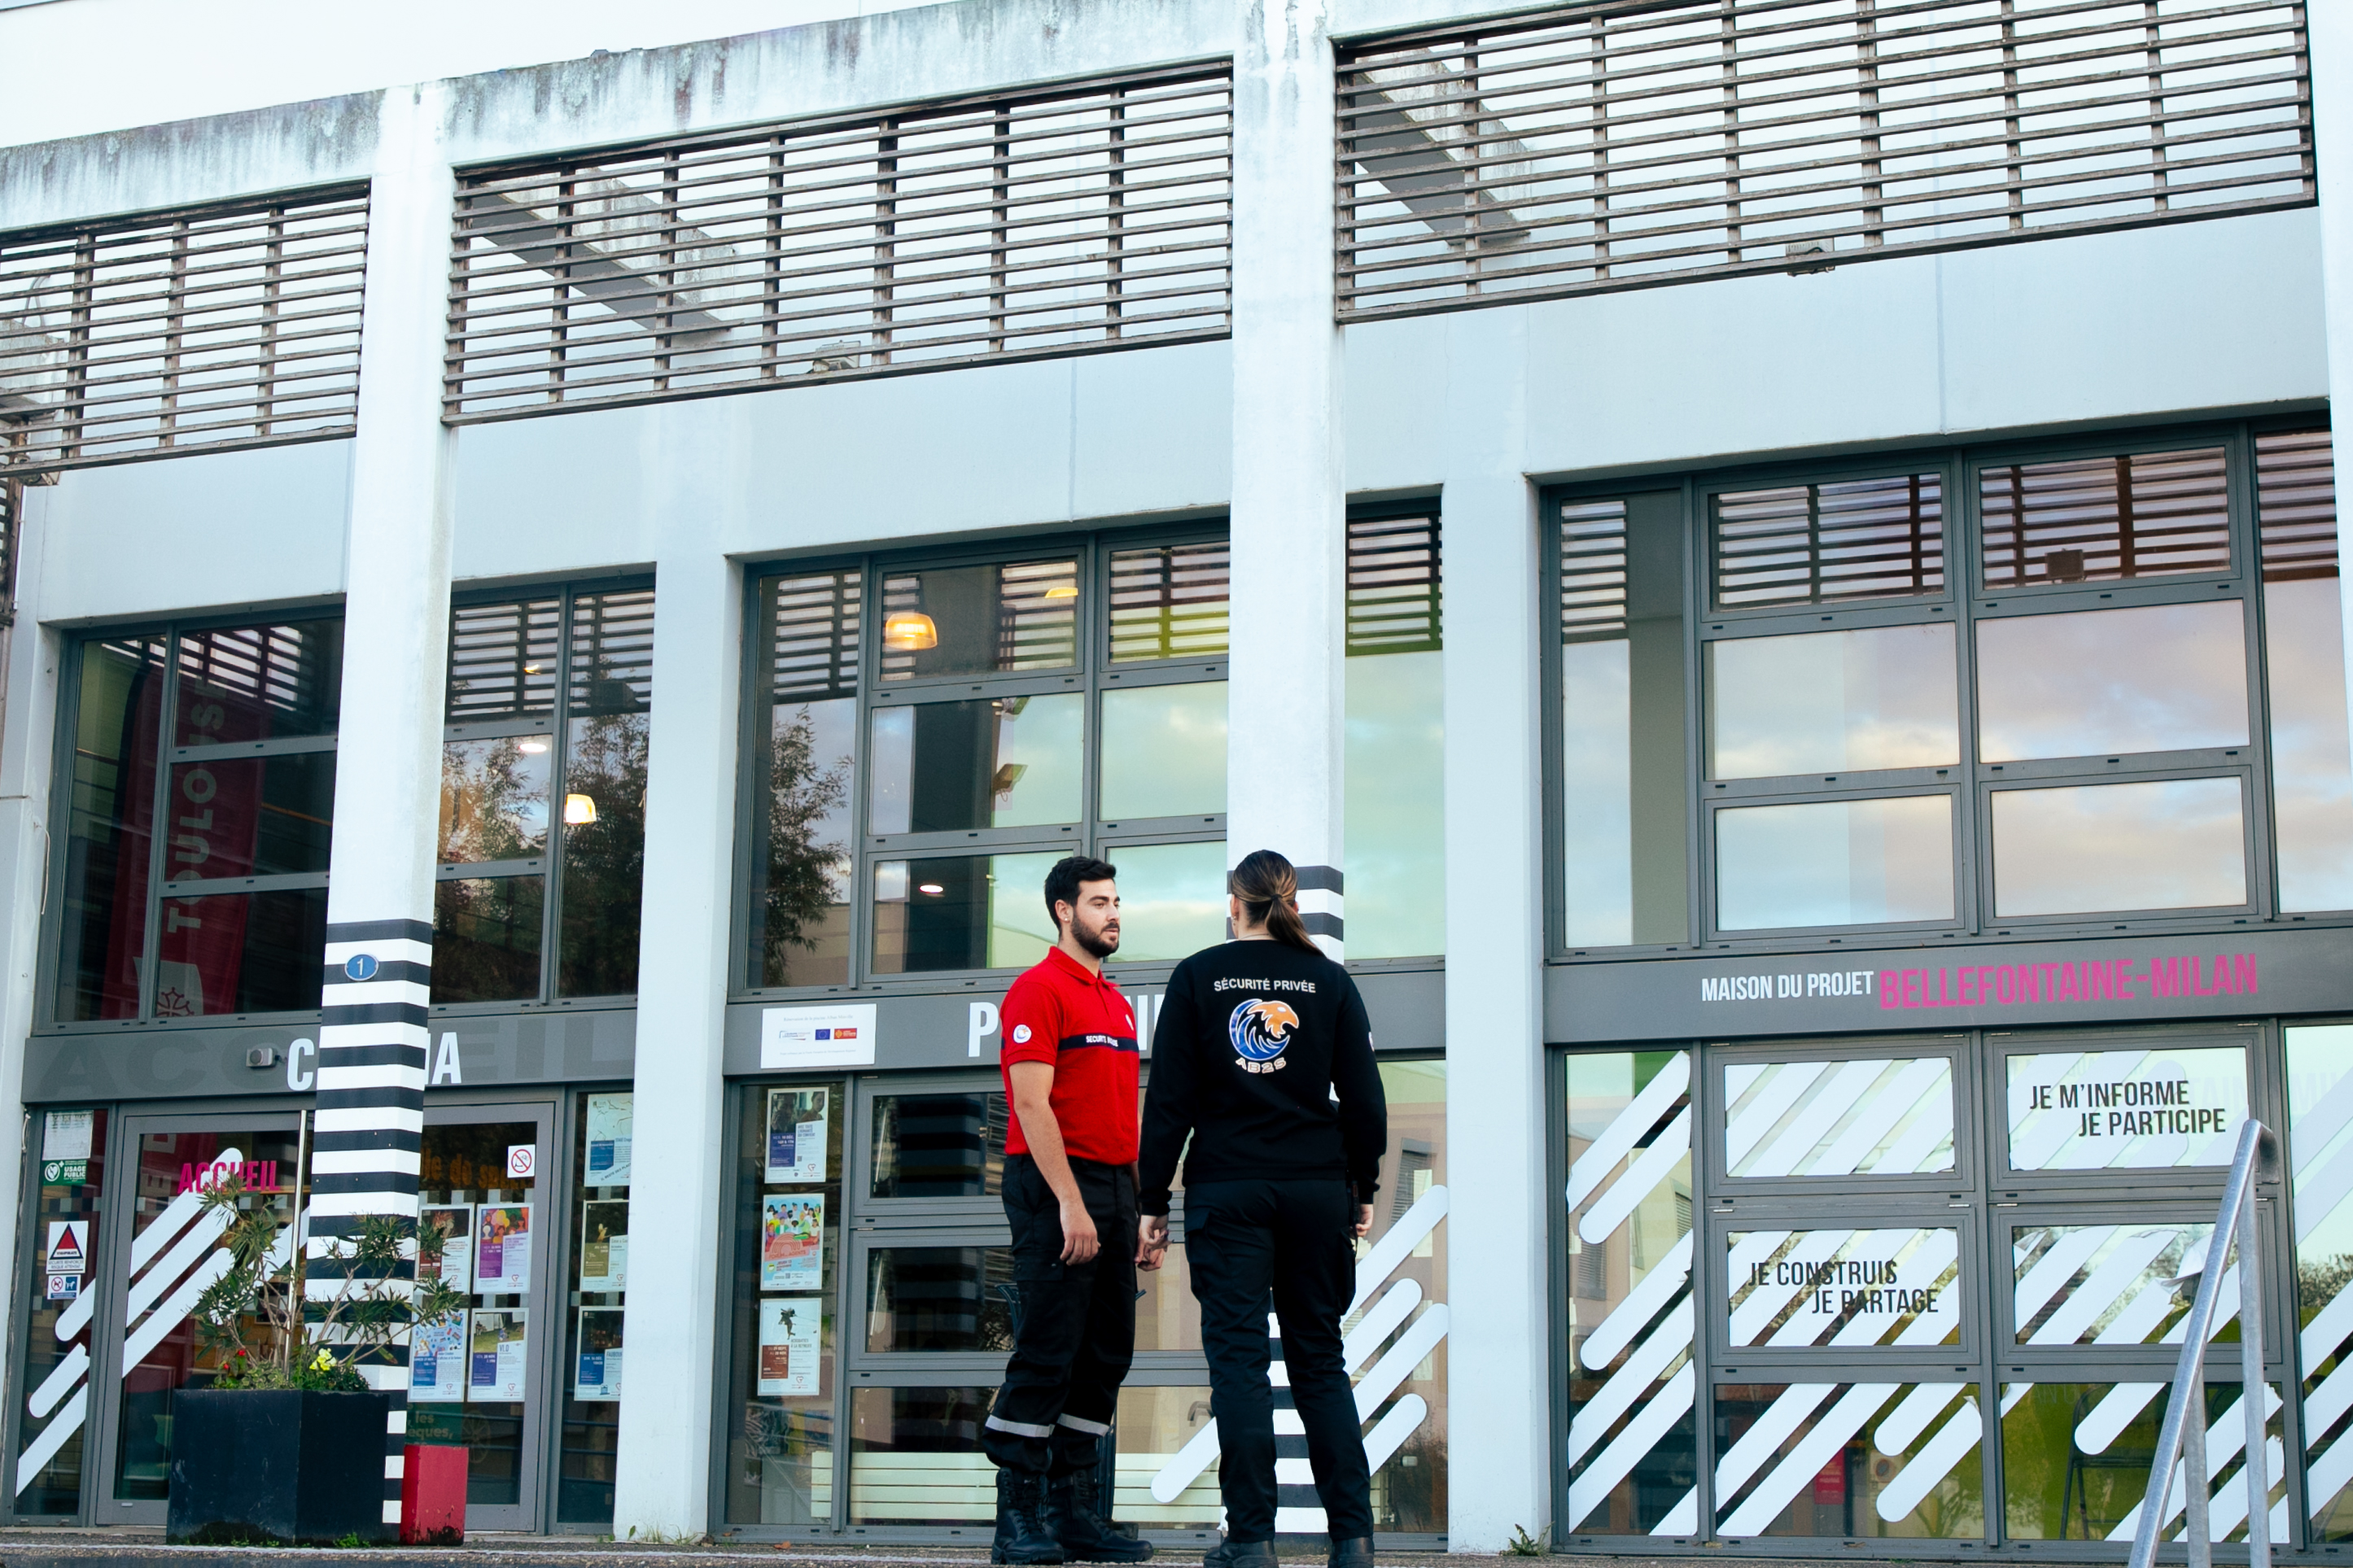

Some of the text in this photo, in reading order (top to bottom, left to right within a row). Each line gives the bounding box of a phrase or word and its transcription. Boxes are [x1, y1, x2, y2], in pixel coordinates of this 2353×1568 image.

[356, 958, 364, 976] 1
[1214, 977, 1316, 994] SÉCURITÉ PRIVÉE
[1702, 953, 2259, 1010] MAISON DU PROJET BELLEFONTAINE-MILAN
[1235, 1057, 1287, 1073] AB2S
[2030, 1085, 2052, 1109] JE
[2079, 1108, 2226, 1137] JE PARTICIPE
[1748, 1260, 1897, 1286] JE CONSTRUIS
[1812, 1289, 1939, 1313] JE PARTAGE
[416, 1411, 434, 1423] les
[408, 1428, 453, 1440] eques,
